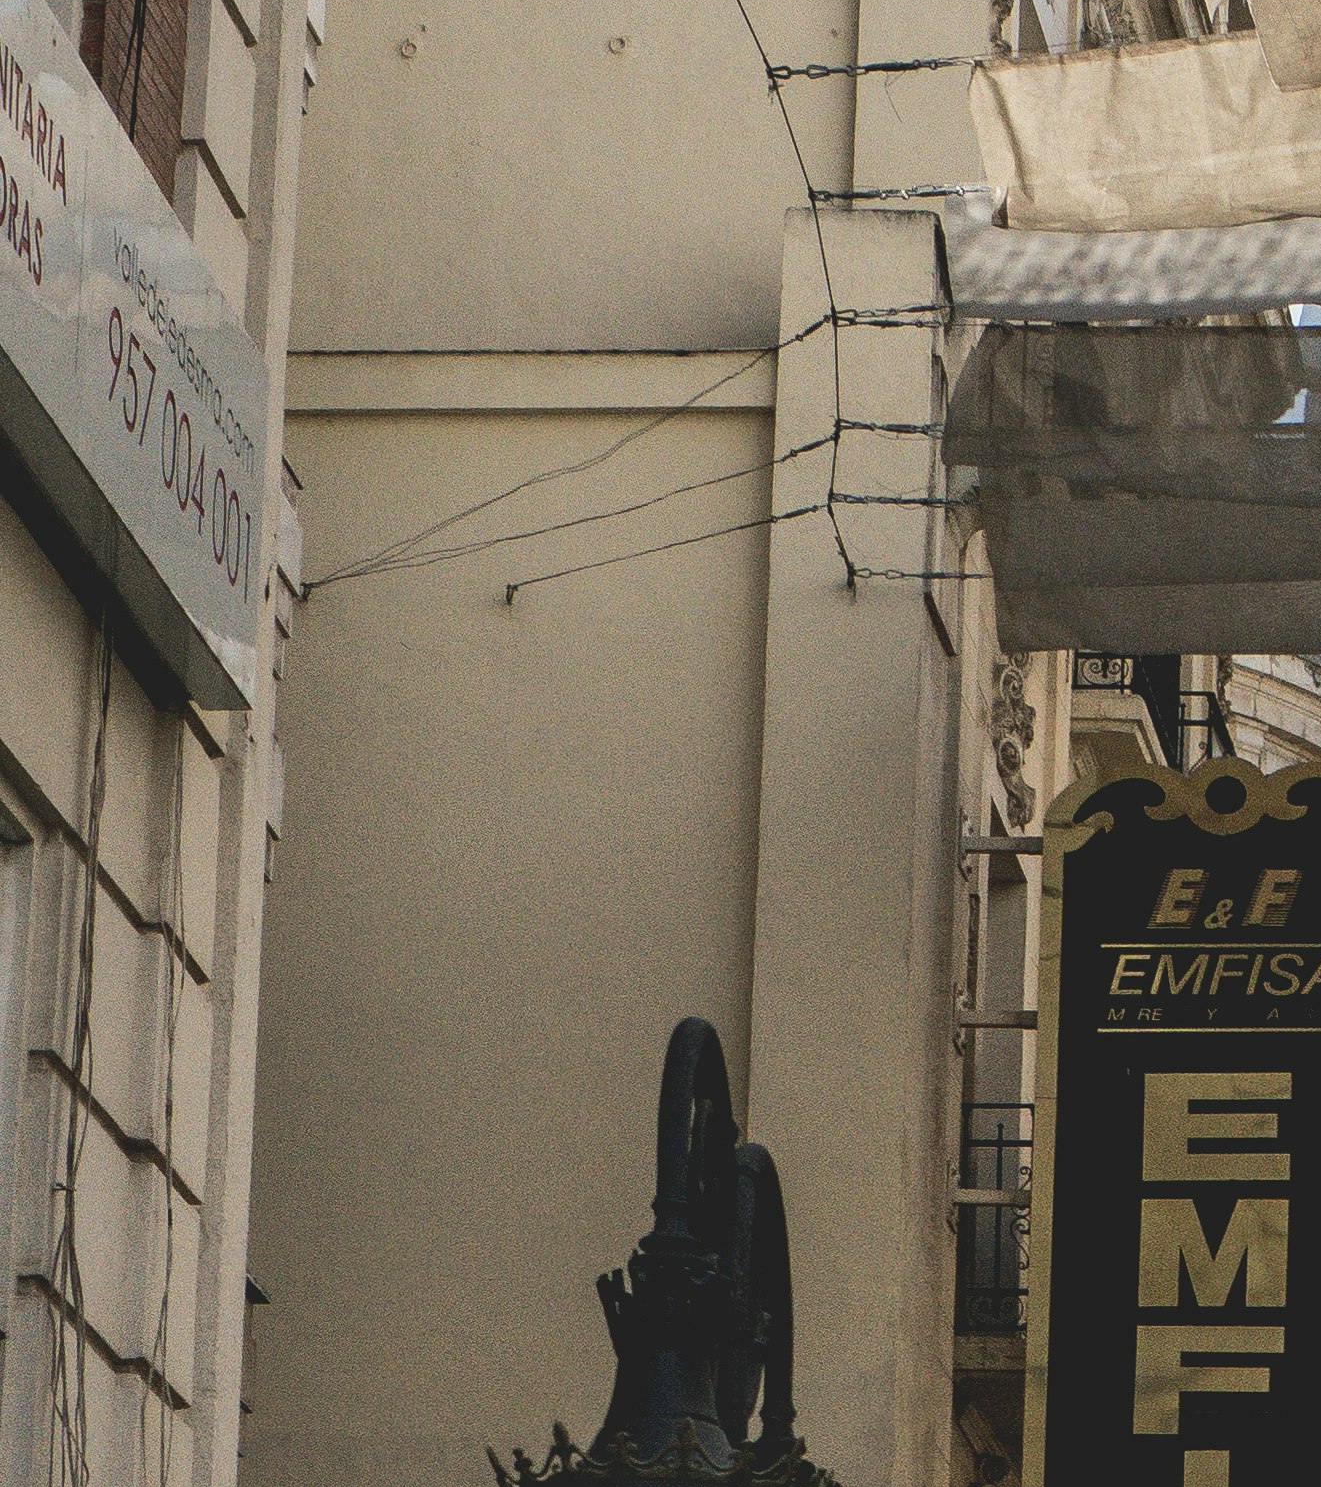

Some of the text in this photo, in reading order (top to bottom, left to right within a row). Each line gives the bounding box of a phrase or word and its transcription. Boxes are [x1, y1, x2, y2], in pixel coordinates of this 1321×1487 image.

[108, 306, 251, 605] 957 004 001
[1147, 868, 1303, 930] E & F
